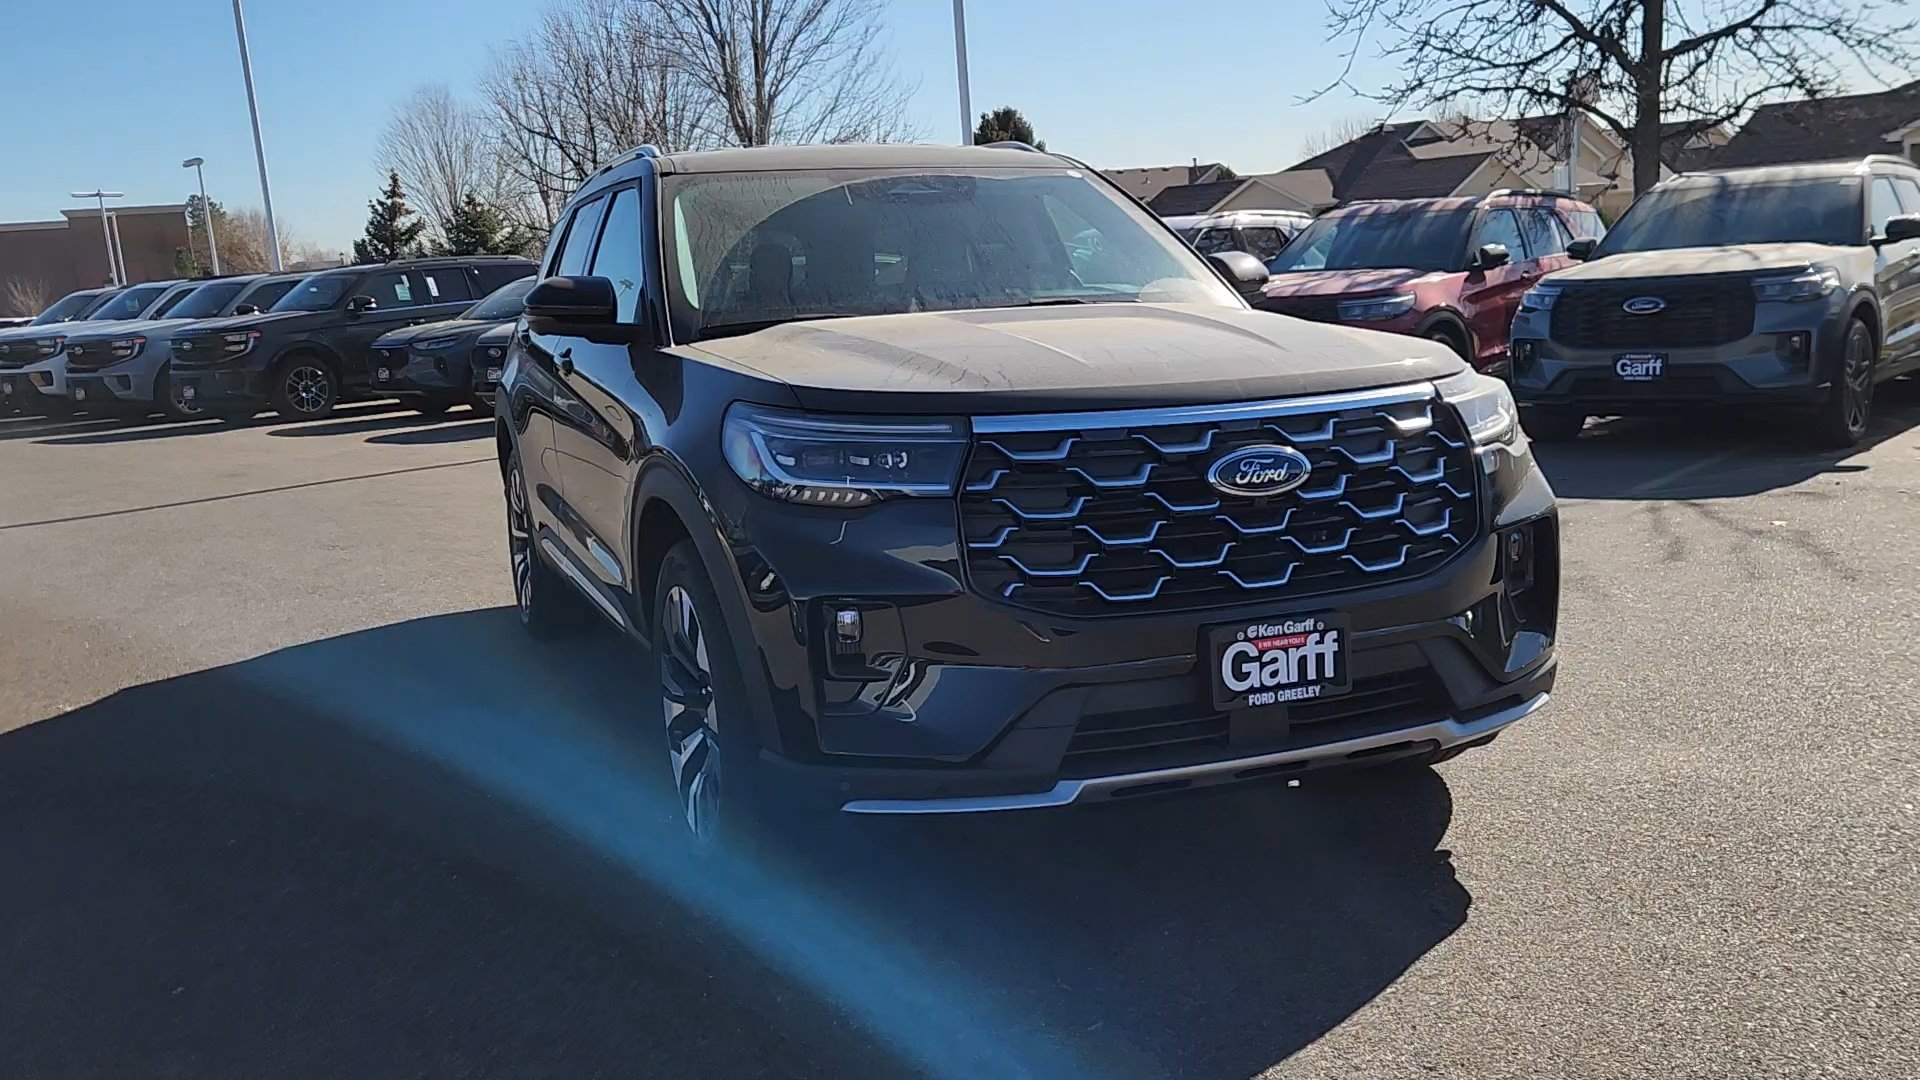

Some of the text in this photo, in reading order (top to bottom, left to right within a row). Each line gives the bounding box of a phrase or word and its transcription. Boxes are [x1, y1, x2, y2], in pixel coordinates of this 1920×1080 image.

[1616, 359, 1662, 376] Garff
[1236, 458, 1289, 484] Ford
[1258, 618, 1315, 638] Ken Garff
[1222, 631, 1338, 692] Garff
[1248, 685, 1321, 706] FORD GREELEY
